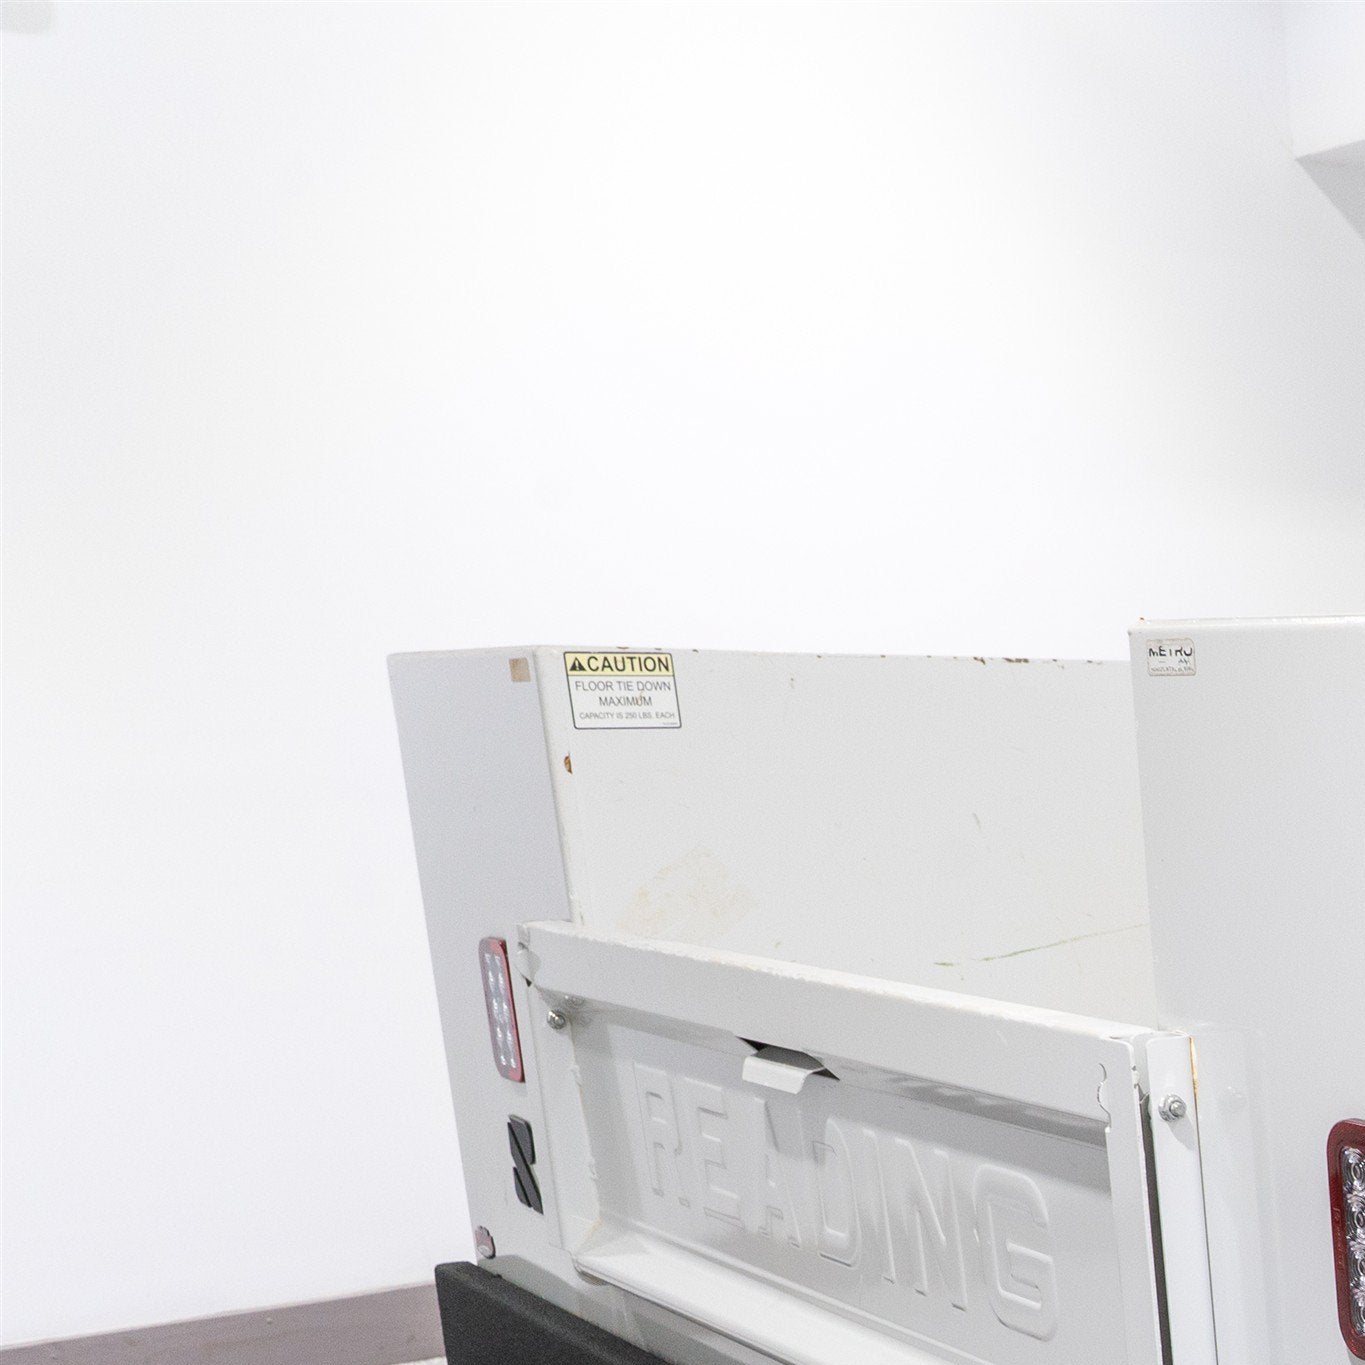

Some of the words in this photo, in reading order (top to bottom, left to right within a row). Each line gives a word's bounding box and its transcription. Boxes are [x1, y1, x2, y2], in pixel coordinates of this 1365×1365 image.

[587, 656, 669, 672] CAUTION
[575, 680, 614, 692] FLOOR
[616, 681, 634, 692] TIE
[637, 681, 671, 692] DOWN
[599, 696, 653, 707] MAXIMUM
[579, 711, 614, 720] CAPACITY
[632, 1060, 1058, 1341] READING
